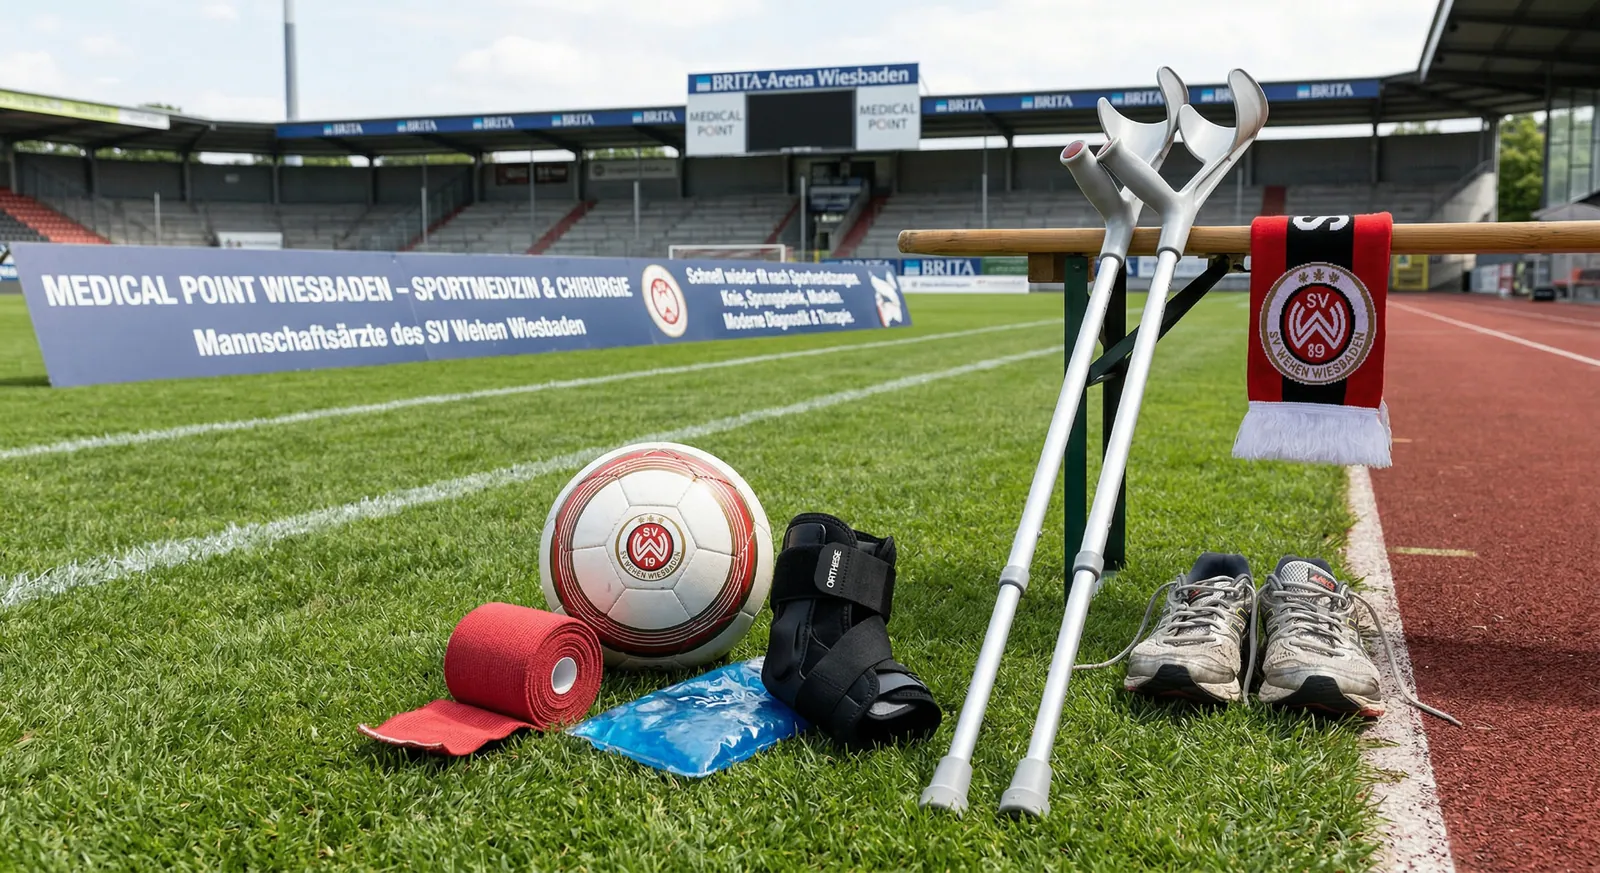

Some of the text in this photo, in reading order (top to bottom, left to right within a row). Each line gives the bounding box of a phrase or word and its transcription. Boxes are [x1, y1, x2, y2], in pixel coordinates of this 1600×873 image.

[712, 67, 909, 91] BRITA-Arena Wiesbaden
[1309, 84, 1354, 98] BRITA
[948, 99, 985, 112] BRITA
[1034, 95, 1073, 108] BRITA
[690, 110, 742, 122] MEDICAL
[860, 103, 916, 116] MEDICAL
[483, 117, 515, 129] BRITA
[562, 114, 595, 126] BRITA
[643, 110, 676, 123] BRITA
[332, 123, 364, 135] BRITA
[406, 120, 437, 132] BRITA
[697, 124, 734, 137] POINT
[868, 118, 908, 130] POINT
[922, 259, 975, 276] BRITA
[686, 267, 725, 284] Schnell
[724, 268, 757, 284] wieder
[41, 274, 179, 307] MEDICAL
[179, 275, 257, 305] POINT
[259, 275, 394, 303] WIESBADEN
[411, 276, 538, 301] SPORTMEDIZIN
[541, 277, 557, 299] &
[555, 276, 633, 298] CHIRURGIE
[1306, 293, 1330, 309] SV
[723, 313, 766, 329] Moderne
[193, 315, 587, 357] Mannschaftsärzte des SV Wehen Wiesbaden
[1269, 331, 1365, 379] SV WEHEN WIESBADEN
[1307, 343, 1325, 358] 89
[643, 527, 659, 537] SV
[644, 557, 656, 567] 19
[624, 560, 647, 579] WEHEN
